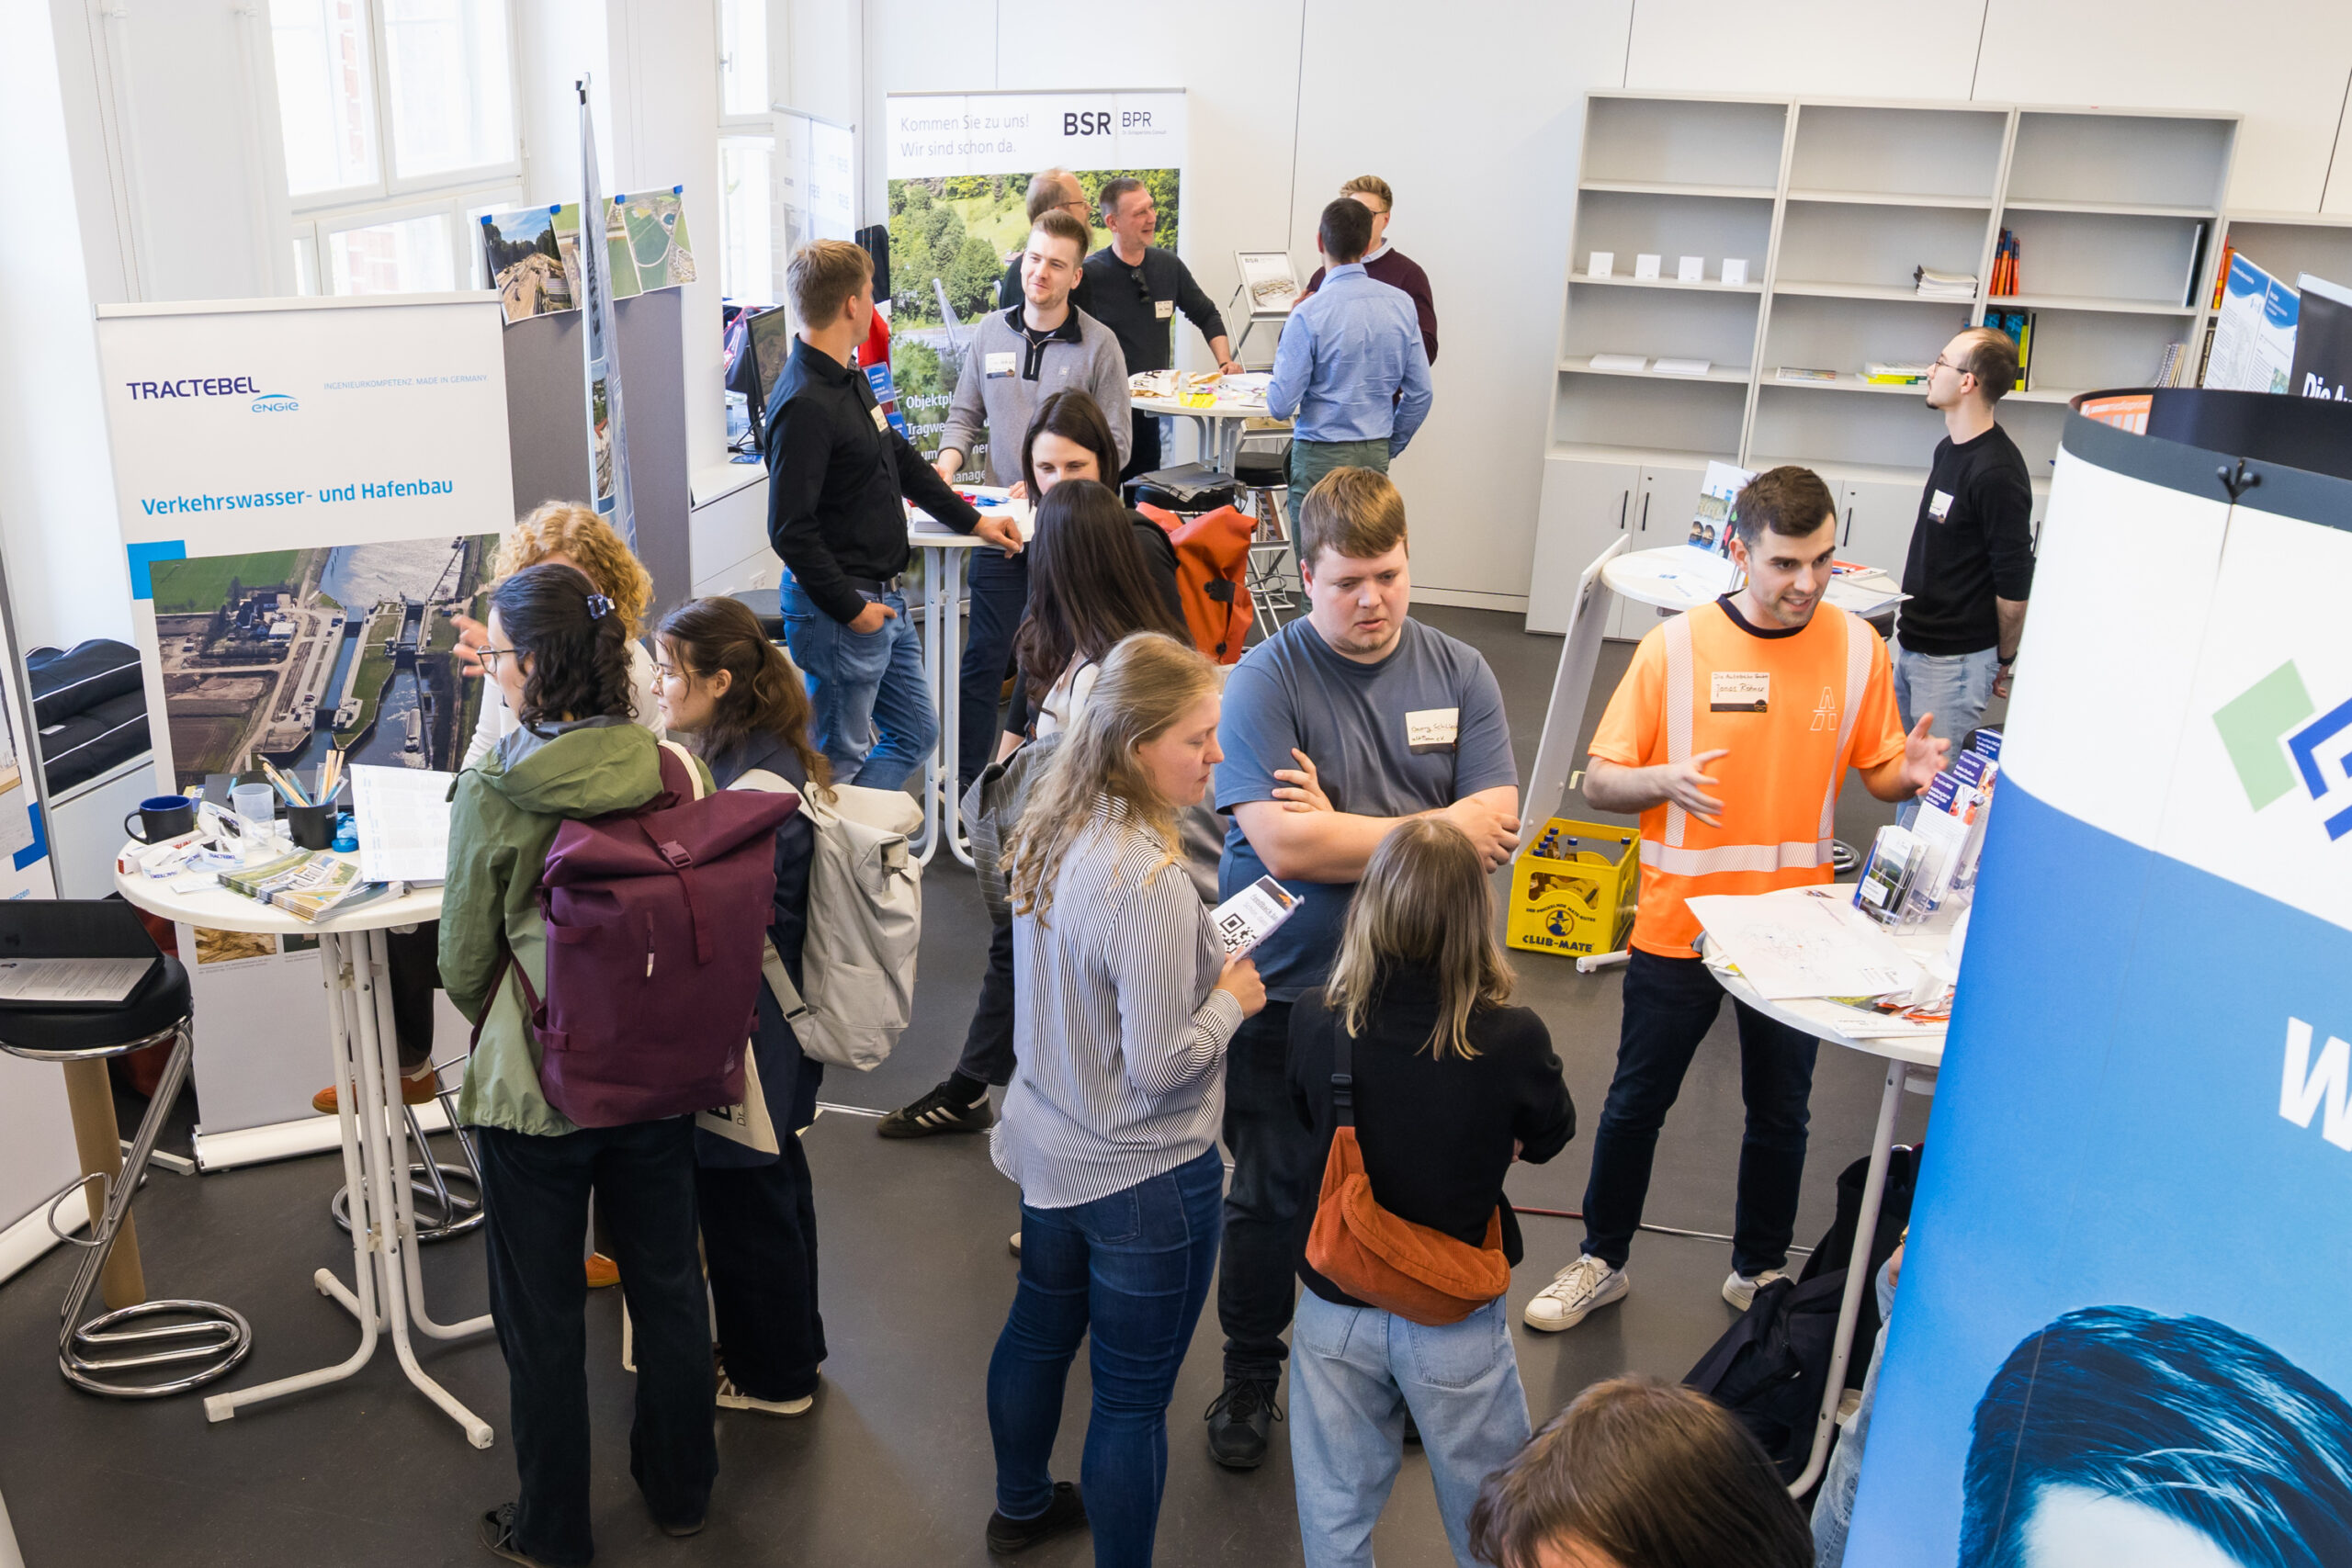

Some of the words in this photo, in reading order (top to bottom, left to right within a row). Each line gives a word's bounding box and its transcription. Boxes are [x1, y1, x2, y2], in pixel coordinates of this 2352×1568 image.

[900, 117, 959, 132] Kommen
[963, 115, 981, 130] Sie
[985, 117, 1000, 129] zu
[1003, 114, 1030, 128] uns!
[1063, 111, 1112, 136] BSR
[1122, 111, 1152, 127] BPR
[900, 142, 926, 157] Wir
[928, 141, 954, 155] sind
[958, 139, 994, 154] schon
[998, 138, 1017, 152] da.
[126, 376, 261, 400] TRACTEBEL
[415, 377, 438, 385] MADE
[906, 423, 945, 437] Tragwe
[141, 489, 313, 516] Verkehrswasser-
[319, 484, 356, 503] und
[361, 479, 454, 500] Hafenbau
[1522, 934, 1593, 953] CLUB-MATE
